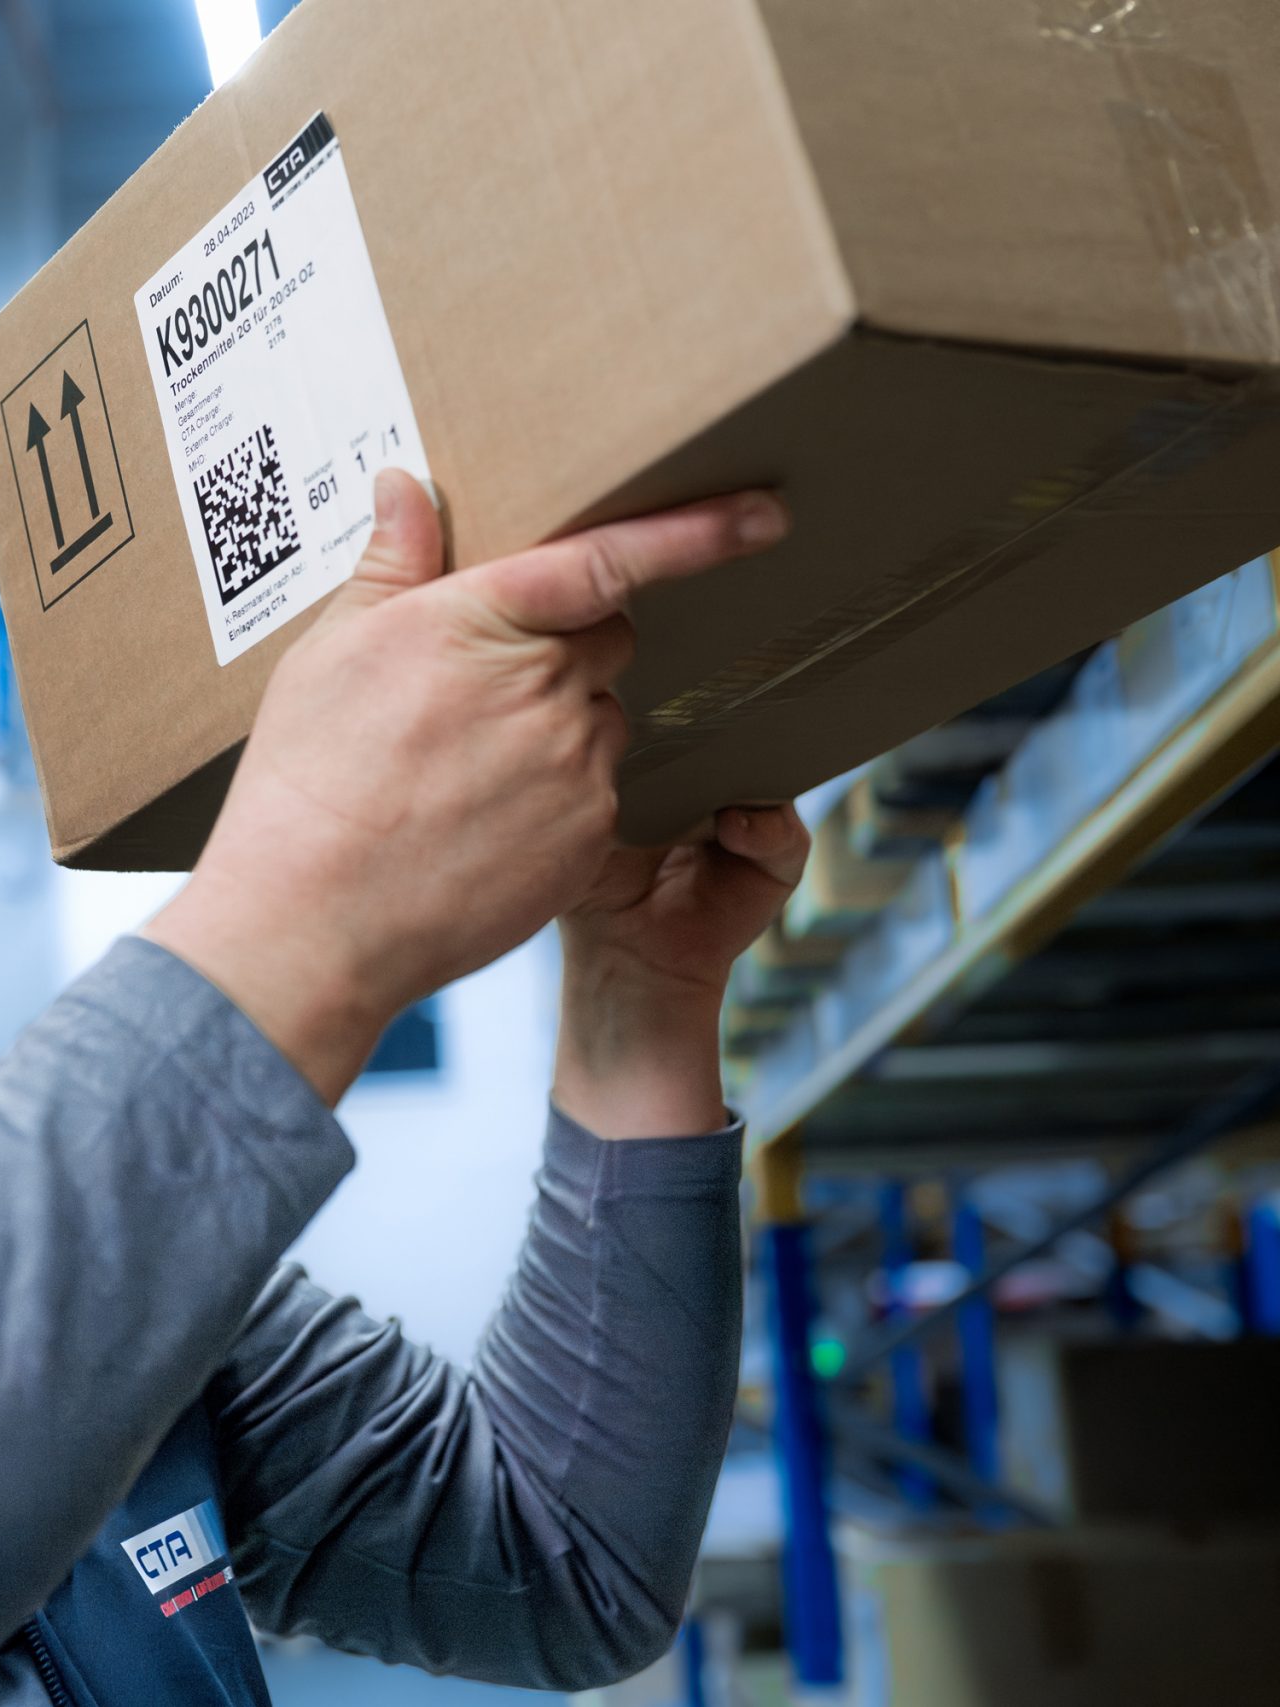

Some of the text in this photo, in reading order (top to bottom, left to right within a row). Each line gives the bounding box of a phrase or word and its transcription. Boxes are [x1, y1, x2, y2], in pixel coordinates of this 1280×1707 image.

[267, 146, 305, 191] CTA
[149, 201, 256, 308] Datum: 28.04.2023
[156, 228, 280, 378] K9300271
[170, 332, 236, 397] Trockenmittel
[236, 319, 252, 340] 2G
[253, 305, 268, 325] für
[298, 262, 315, 284] OZ
[174, 389, 198, 413] Menge:
[181, 424, 196, 442] CTA
[354, 450, 366, 473] 1
[308, 474, 338, 511] 601
[228, 594, 287, 641] Einlagerung CTA
[136, 1530, 192, 1579] CTA
